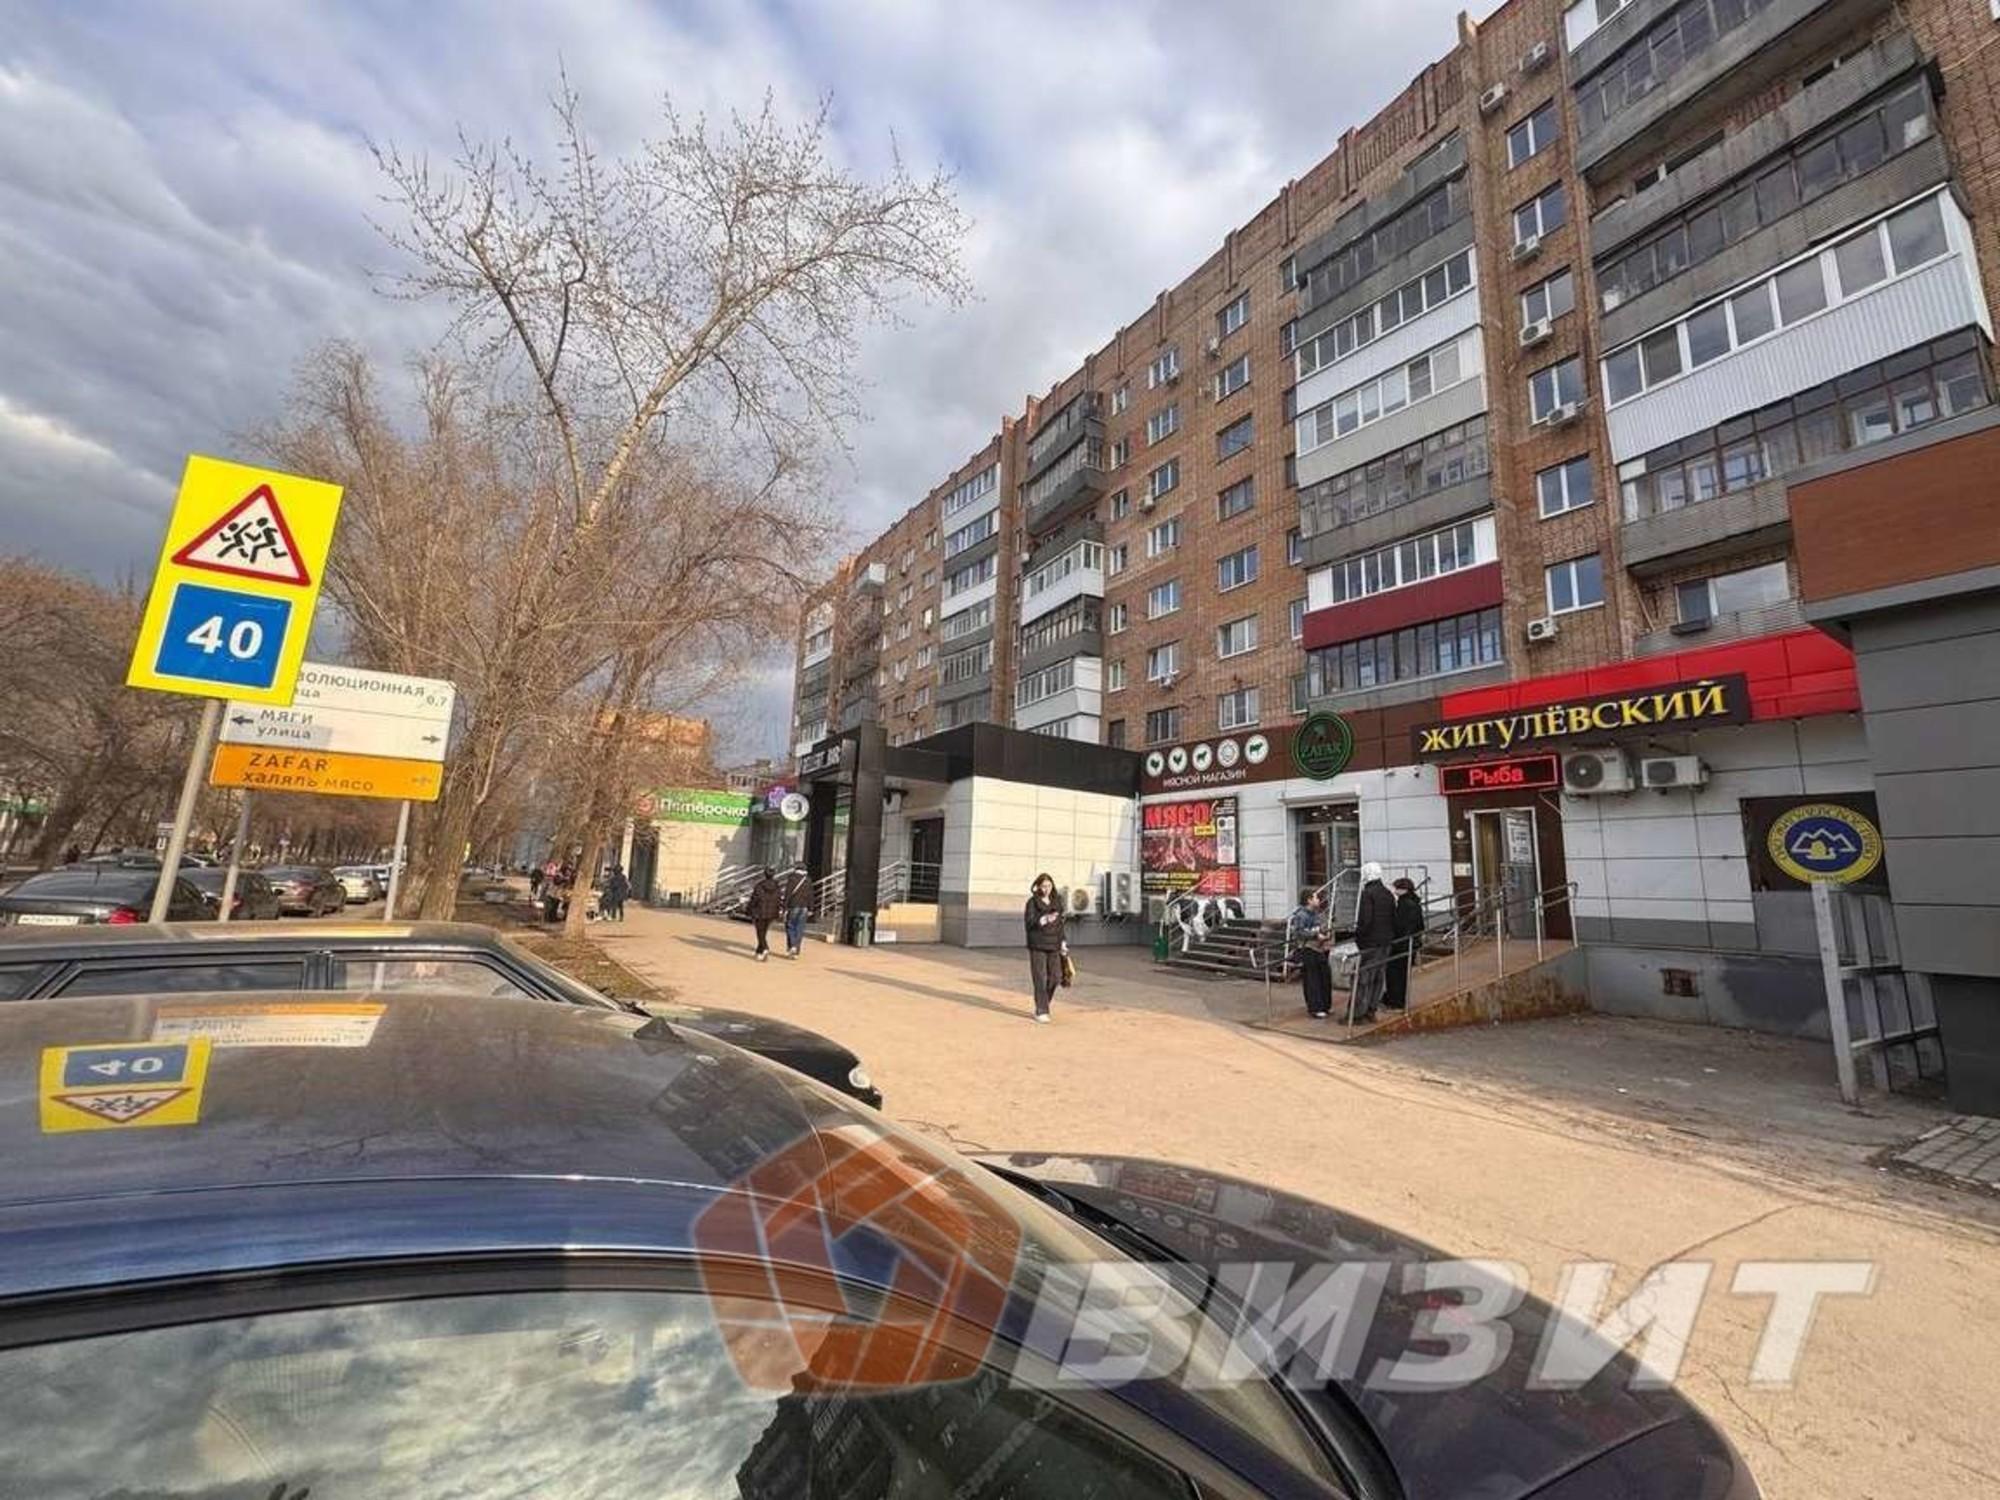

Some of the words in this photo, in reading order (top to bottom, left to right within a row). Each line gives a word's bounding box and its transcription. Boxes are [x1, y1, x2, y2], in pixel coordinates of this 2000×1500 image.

[187, 616, 263, 658] 40
[260, 709, 313, 725] МЯГИ
[1420, 680, 1730, 752] ЖИГУЛЁВСКИЙ
[257, 726, 311, 740] улица
[249, 752, 329, 773] ZAFAR
[324, 777, 374, 792] мясо
[1202, 769, 1246, 783] МАГАЗИН
[1469, 765, 1525, 786] Рыба
[1145, 802, 1210, 829] МЯСО
